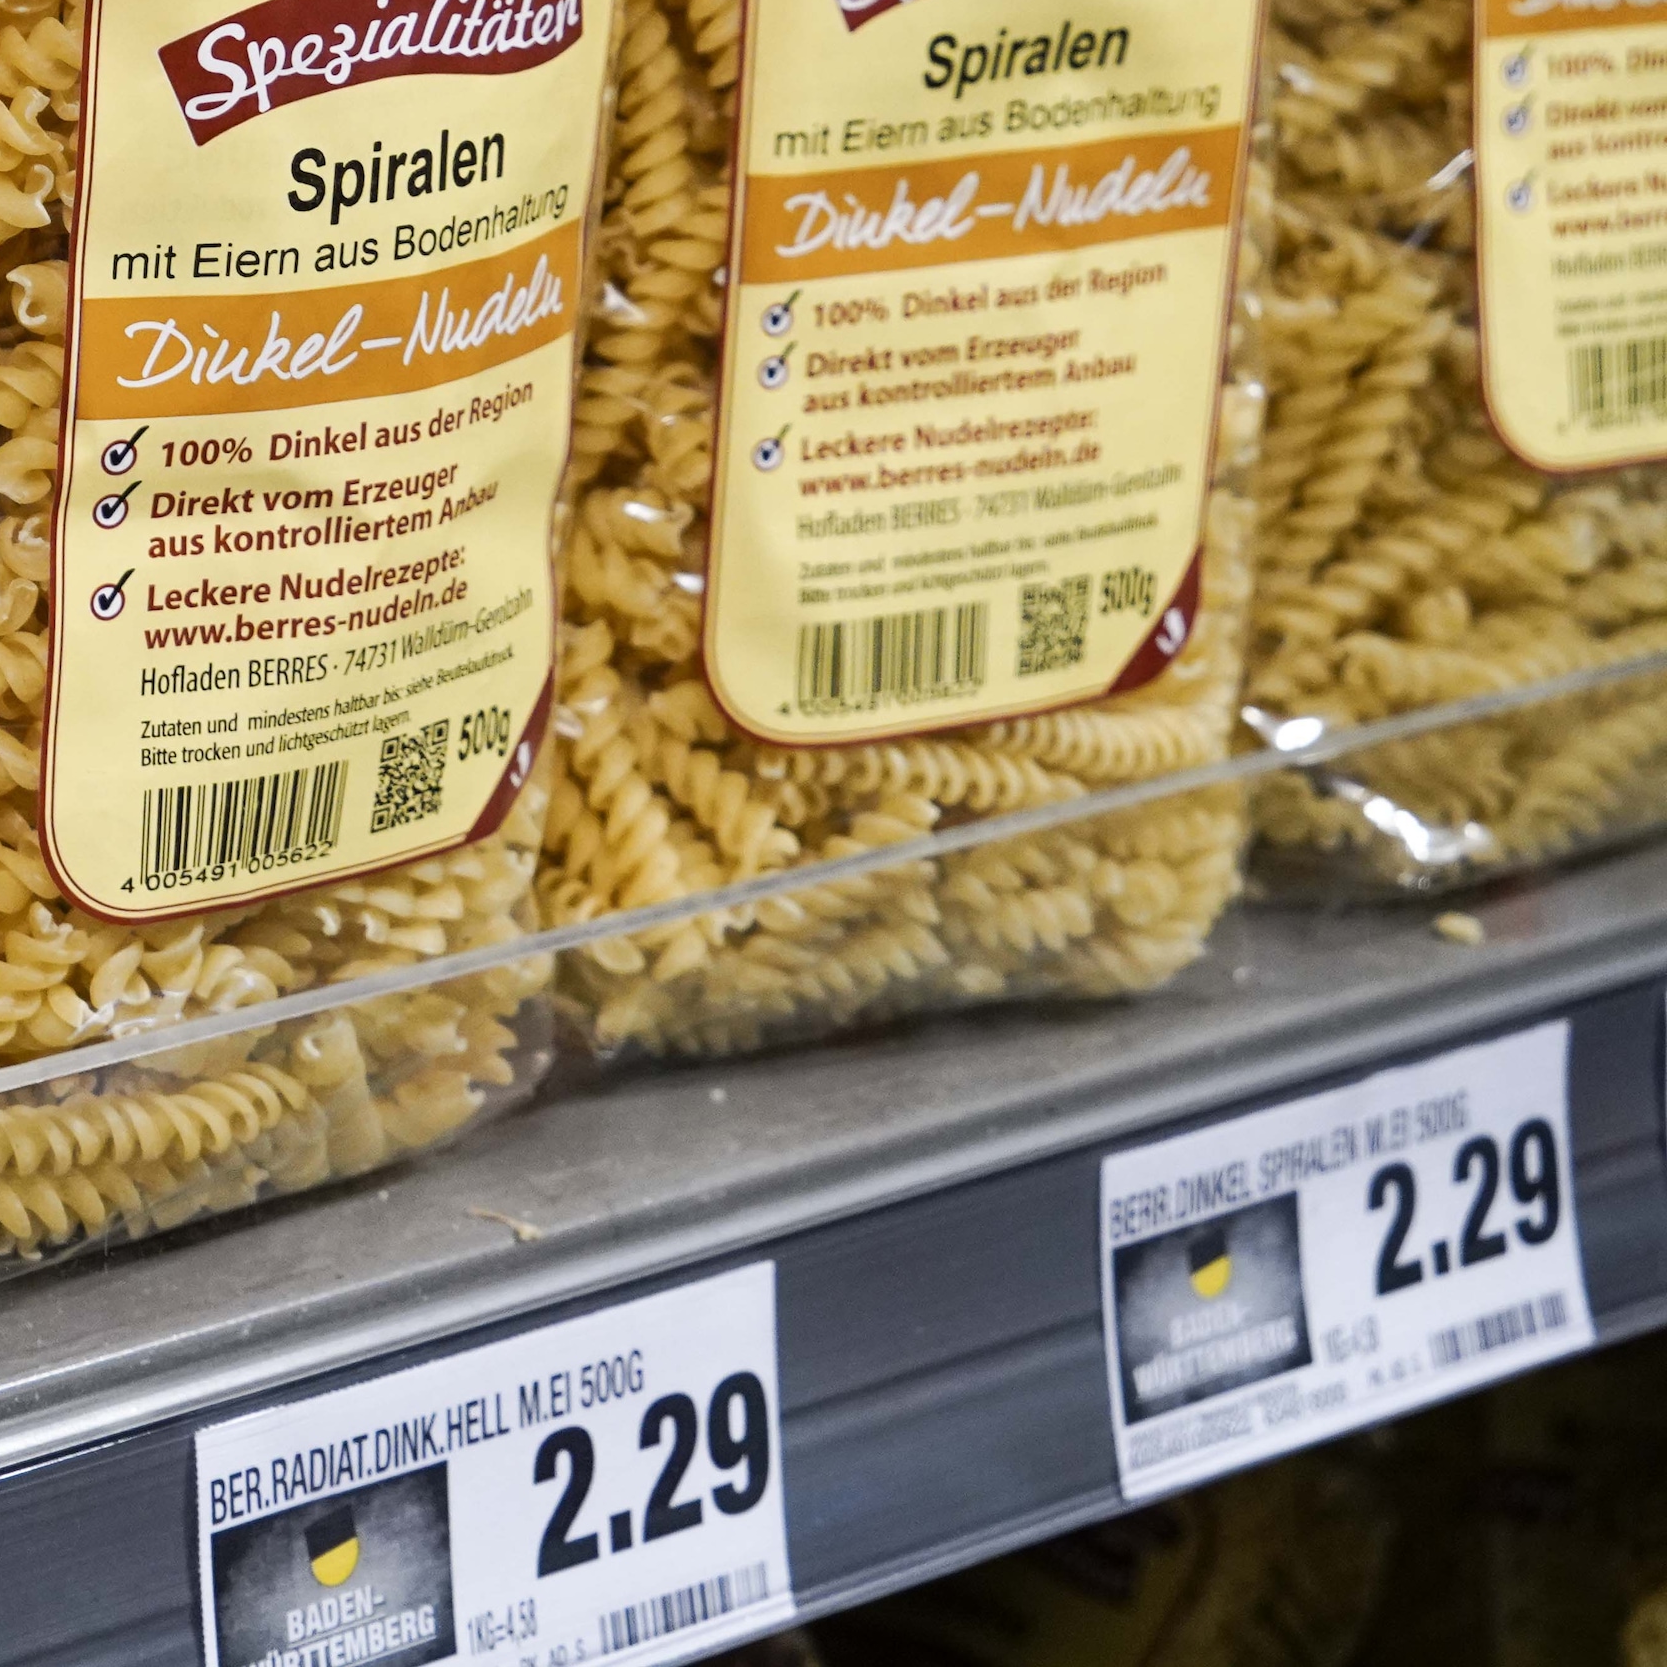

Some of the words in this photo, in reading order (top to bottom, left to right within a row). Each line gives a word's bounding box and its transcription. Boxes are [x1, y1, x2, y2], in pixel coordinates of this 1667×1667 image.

[924, 20, 1130, 100] Spiralen
[774, 128, 829, 158] mit
[842, 117, 929, 153] Eiern
[939, 114, 994, 142] aus
[1006, 83, 1221, 134] Bodenhaltung
[287, 130, 506, 225] Spiralen
[775, 145, 1210, 258] Dinkel-Nudeln
[112, 244, 176, 280] mit
[193, 242, 300, 278] Eiern
[315, 235, 379, 273] aus
[393, 183, 569, 262] Bodenhaltung
[117, 253, 562, 388] Dinkel-Nudeln
[814, 297, 889, 327] 100%
[902, 282, 989, 318] Dinkel
[806, 345, 892, 378] Direkt
[900, 344, 960, 366] vom
[162, 436, 253, 467] 100%
[269, 421, 367, 461] Dinkel
[374, 420, 421, 449] aus
[428, 407, 466, 438] der
[469, 381, 533, 425] Region
[804, 391, 850, 413] aus
[801, 430, 906, 461] Leckere
[148, 533, 204, 559] aus
[214, 506, 432, 554] kontrolliertem
[439, 481, 499, 525] Anbau
[150, 487, 254, 519] Direkt
[263, 488, 333, 511] vom
[342, 463, 458, 506] Erzeuger
[147, 578, 271, 612] Leckere
[279, 545, 466, 601] Nudelrezepte:
[144, 576, 467, 650] www.berres-nudeln.de
[141, 662, 240, 696] Hofladen
[248, 654, 328, 688] BERRES
[343, 639, 397, 676] 74731
[141, 720, 201, 739] Zutaten
[207, 713, 238, 734] und
[248, 702, 329, 730] mindestens
[334, 693, 379, 715] haltbar
[141, 748, 177, 767] Bitte
[182, 742, 240, 764] trocken
[246, 736, 274, 757] und
[278, 718, 369, 752] lichtgeschützt
[459, 704, 510, 761] 500g
[121, 877, 135, 893] 4
[145, 863, 238, 891] 005491
[248, 840, 333, 874] 005622
[1367, 1117, 1560, 1298] 2.29
[210, 1392, 511, 1526] BER.RADIAT.DINK.HELL
[519, 1371, 571, 1428] M.EI
[580, 1348, 643, 1408] 500G
[532, 1370, 768, 1580] 2.29
[242, 1604, 436, 1667] RTTEMBERG
[286, 1585, 385, 1643] BADEN-
